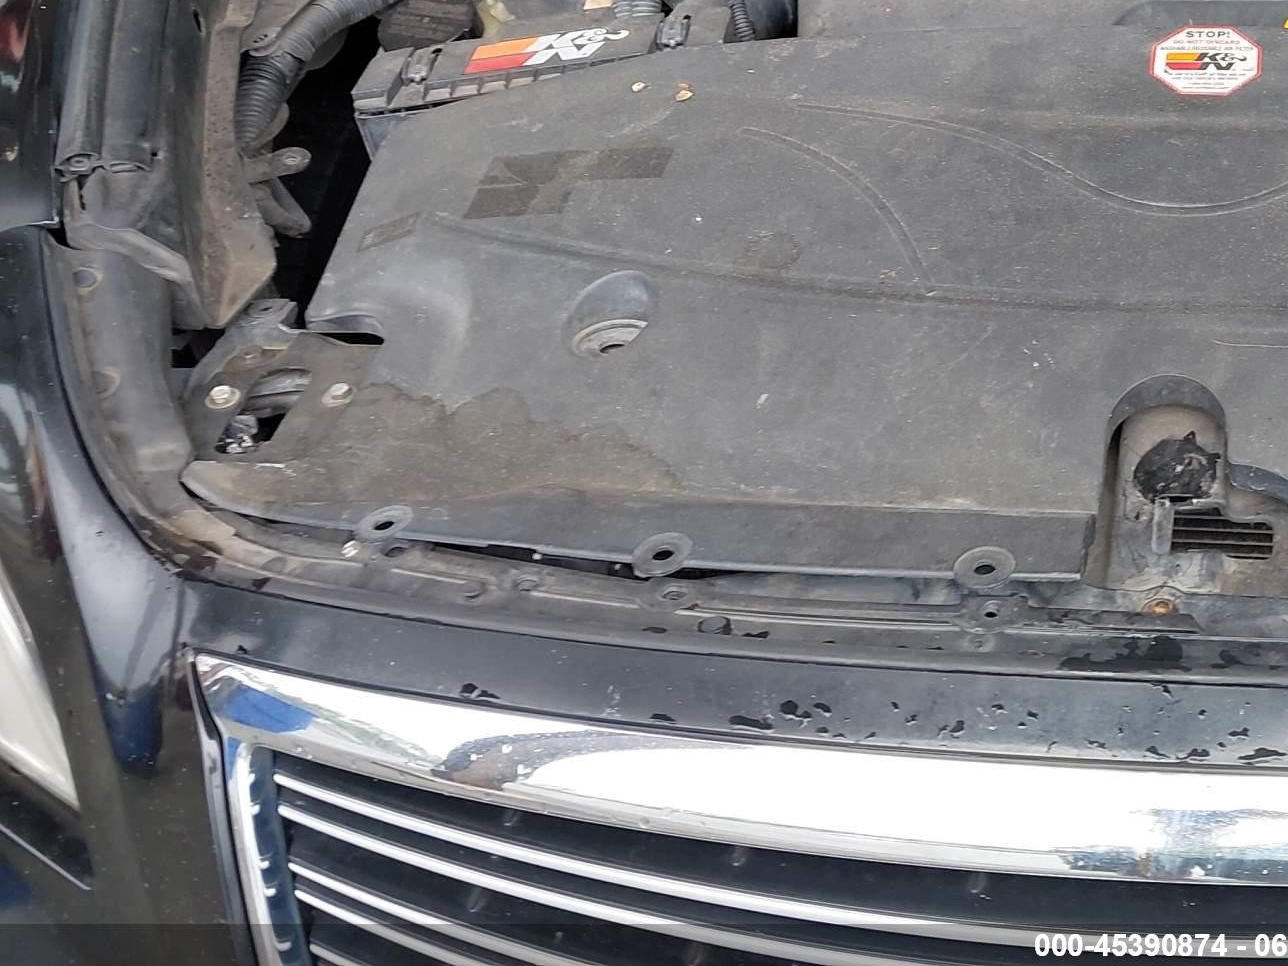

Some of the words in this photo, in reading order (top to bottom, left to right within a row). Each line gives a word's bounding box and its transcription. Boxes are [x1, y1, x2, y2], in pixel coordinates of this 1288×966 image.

[1185, 30, 1231, 38] STOP!
[522, 28, 630, 67] K&N
[1195, 52, 1247, 71] K&N
